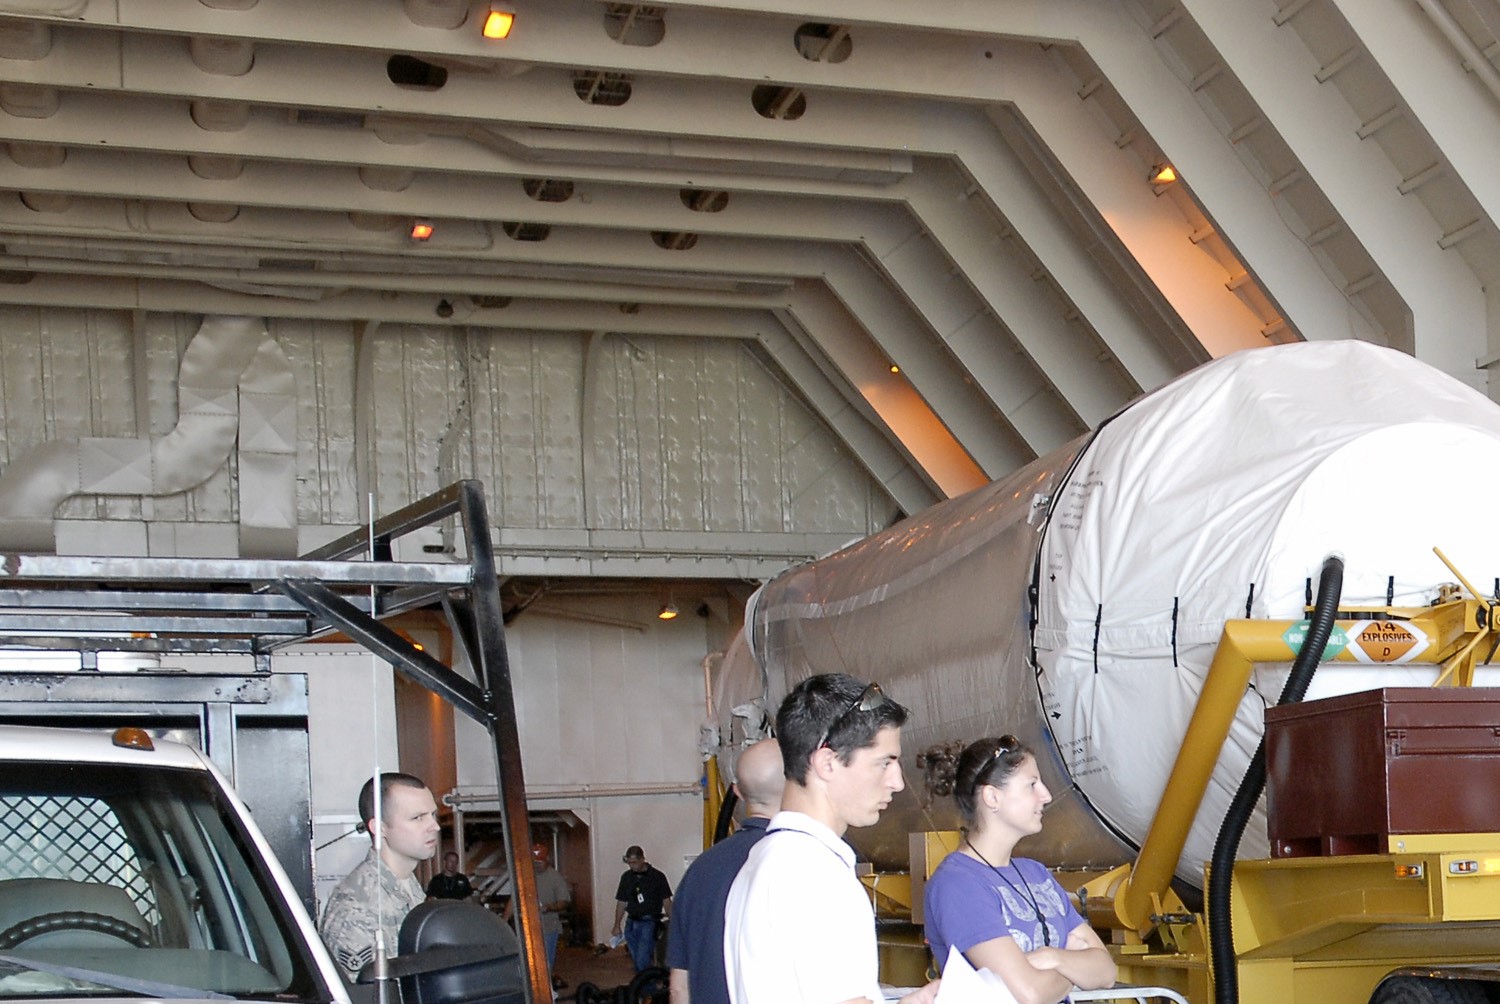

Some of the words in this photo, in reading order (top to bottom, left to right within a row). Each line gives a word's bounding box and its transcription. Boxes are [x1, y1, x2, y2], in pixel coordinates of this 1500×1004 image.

[1375, 622, 1396, 632] 1.4
[1362, 632, 1412, 642] EXPLOSIVES
[1383, 647, 1391, 656] D
